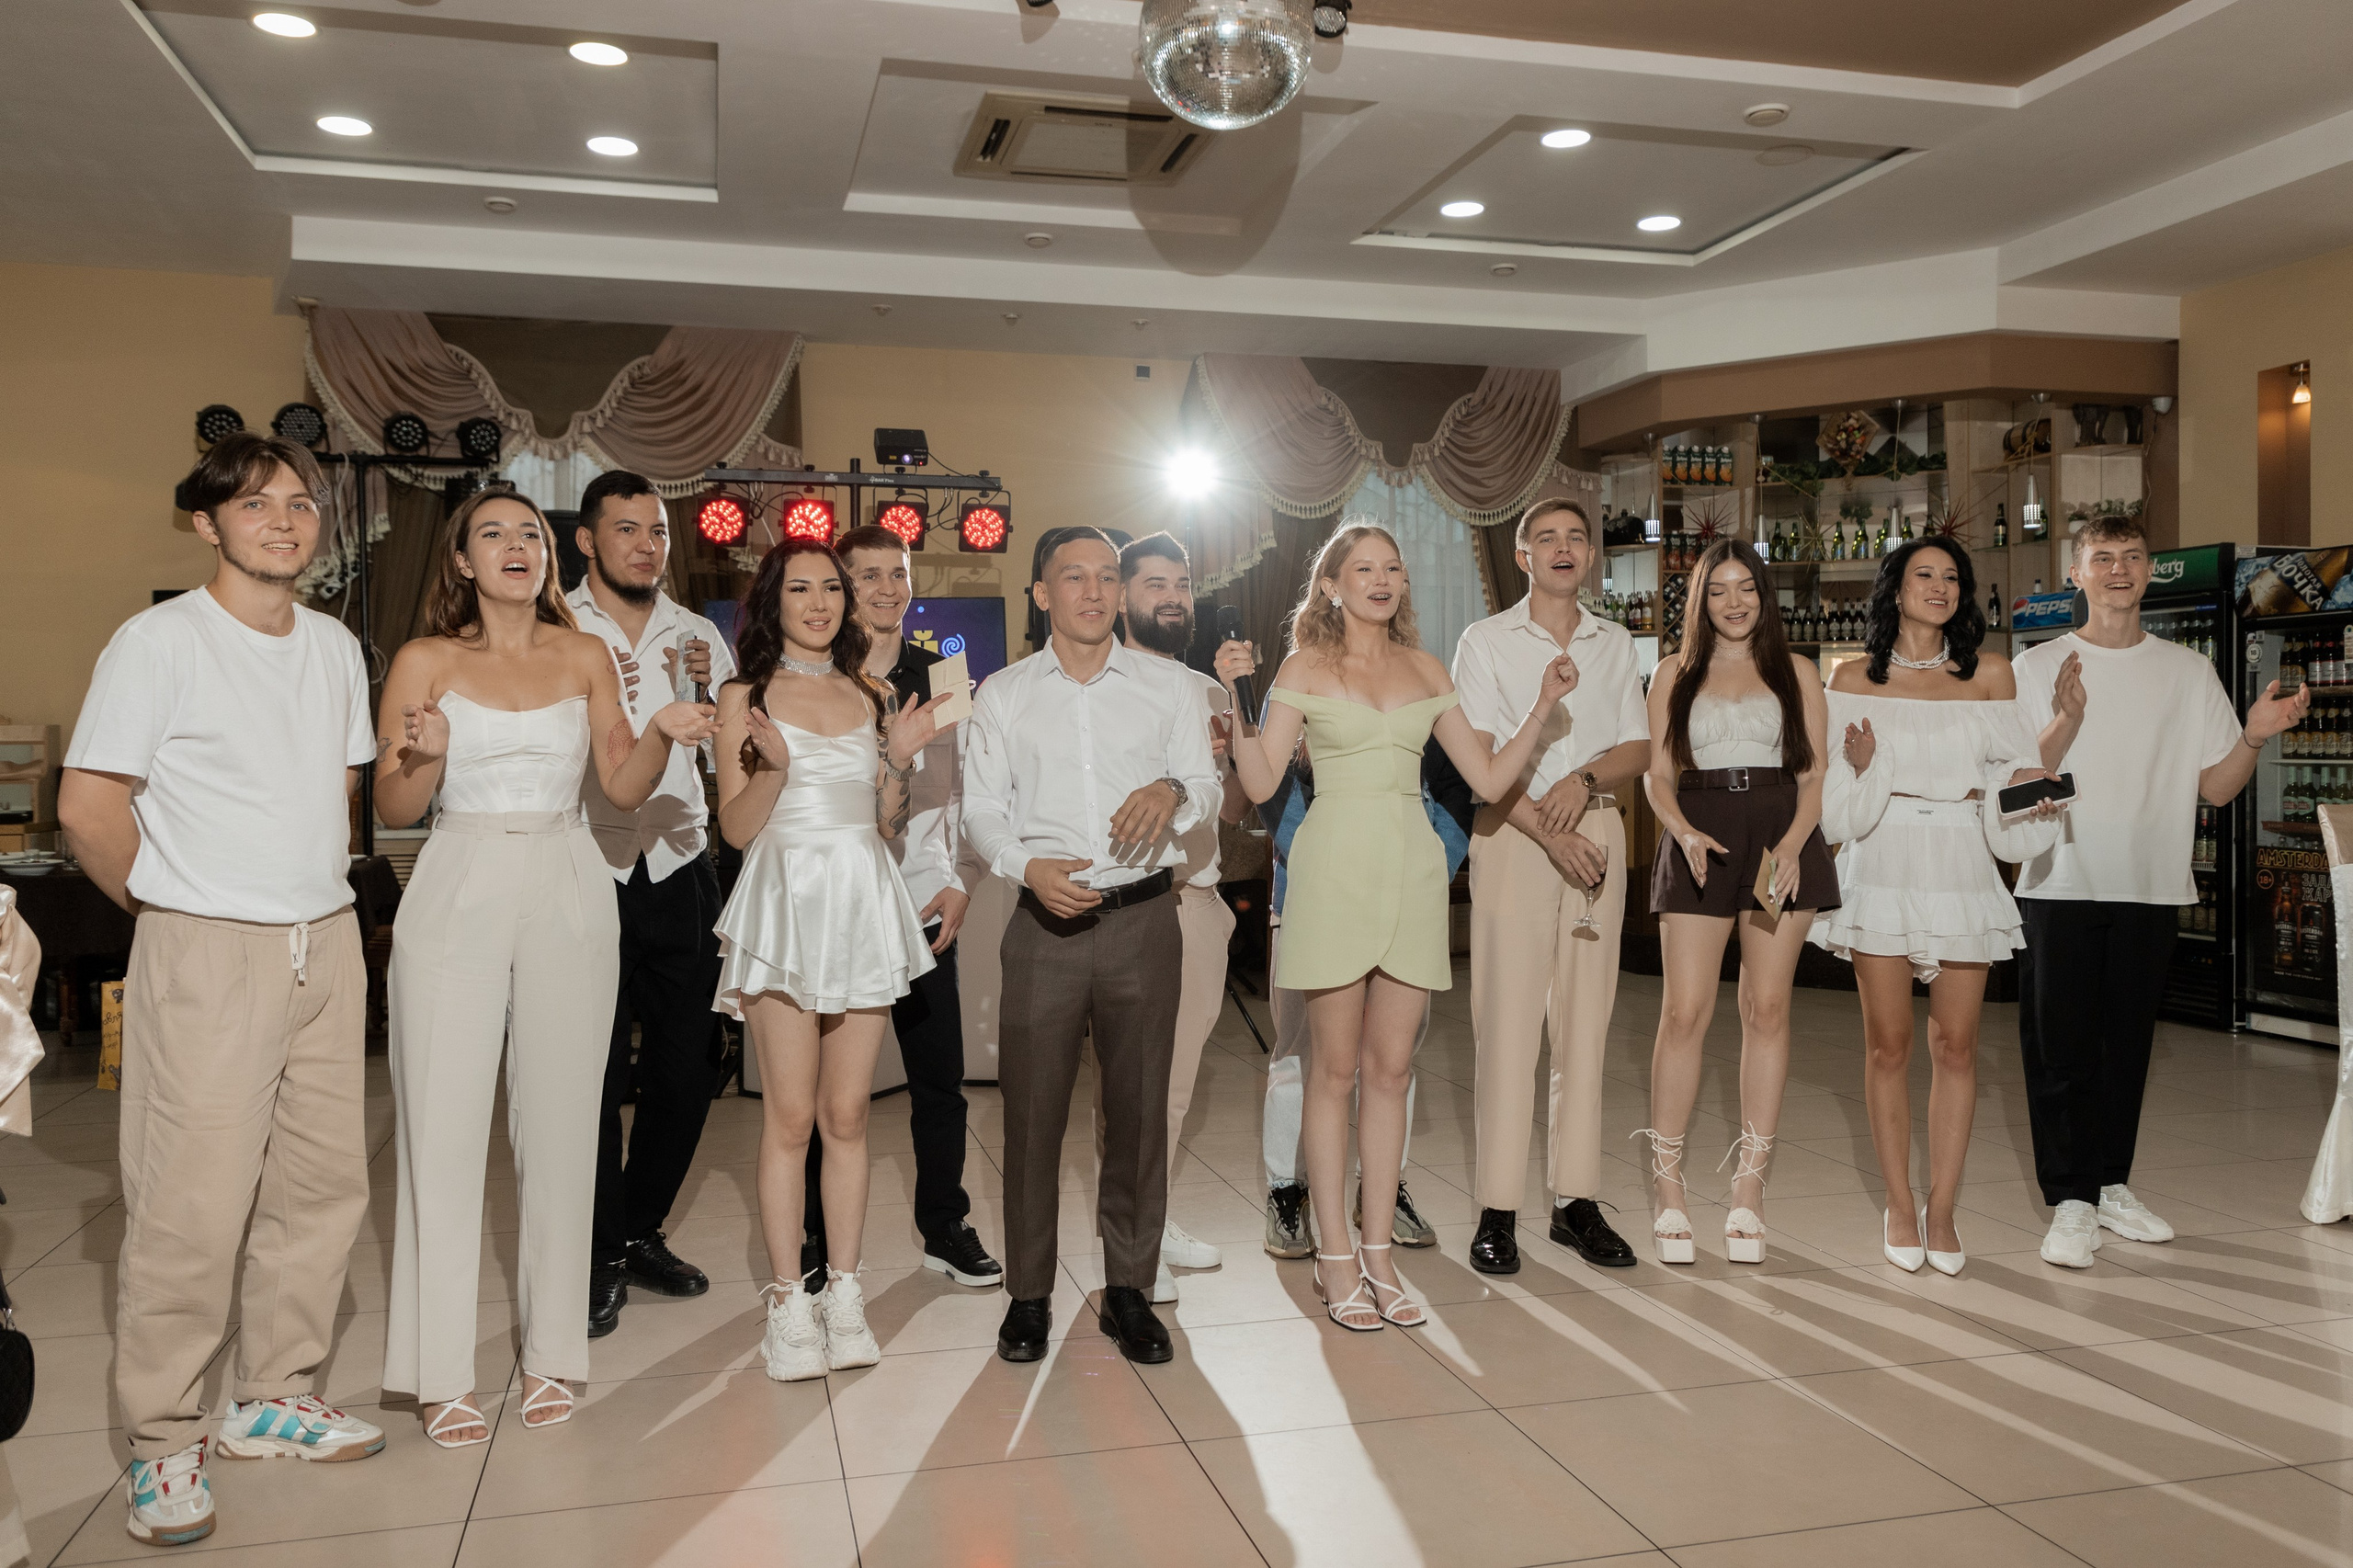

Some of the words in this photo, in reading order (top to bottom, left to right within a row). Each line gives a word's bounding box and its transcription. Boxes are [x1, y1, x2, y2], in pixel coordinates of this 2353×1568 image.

[2153, 558, 2185, 578] berg
[2296, 557, 2323, 590] ЗОЛОТАЯ
[2273, 554, 2325, 611] БОЧКА
[2256, 848, 2330, 870] AMSTERDA
[2259, 875, 2272, 884] 18+
[2302, 872, 2333, 889] ЗАДА
[2302, 886, 2335, 903] ЖАР
[102, 1011, 122, 1025] авля
